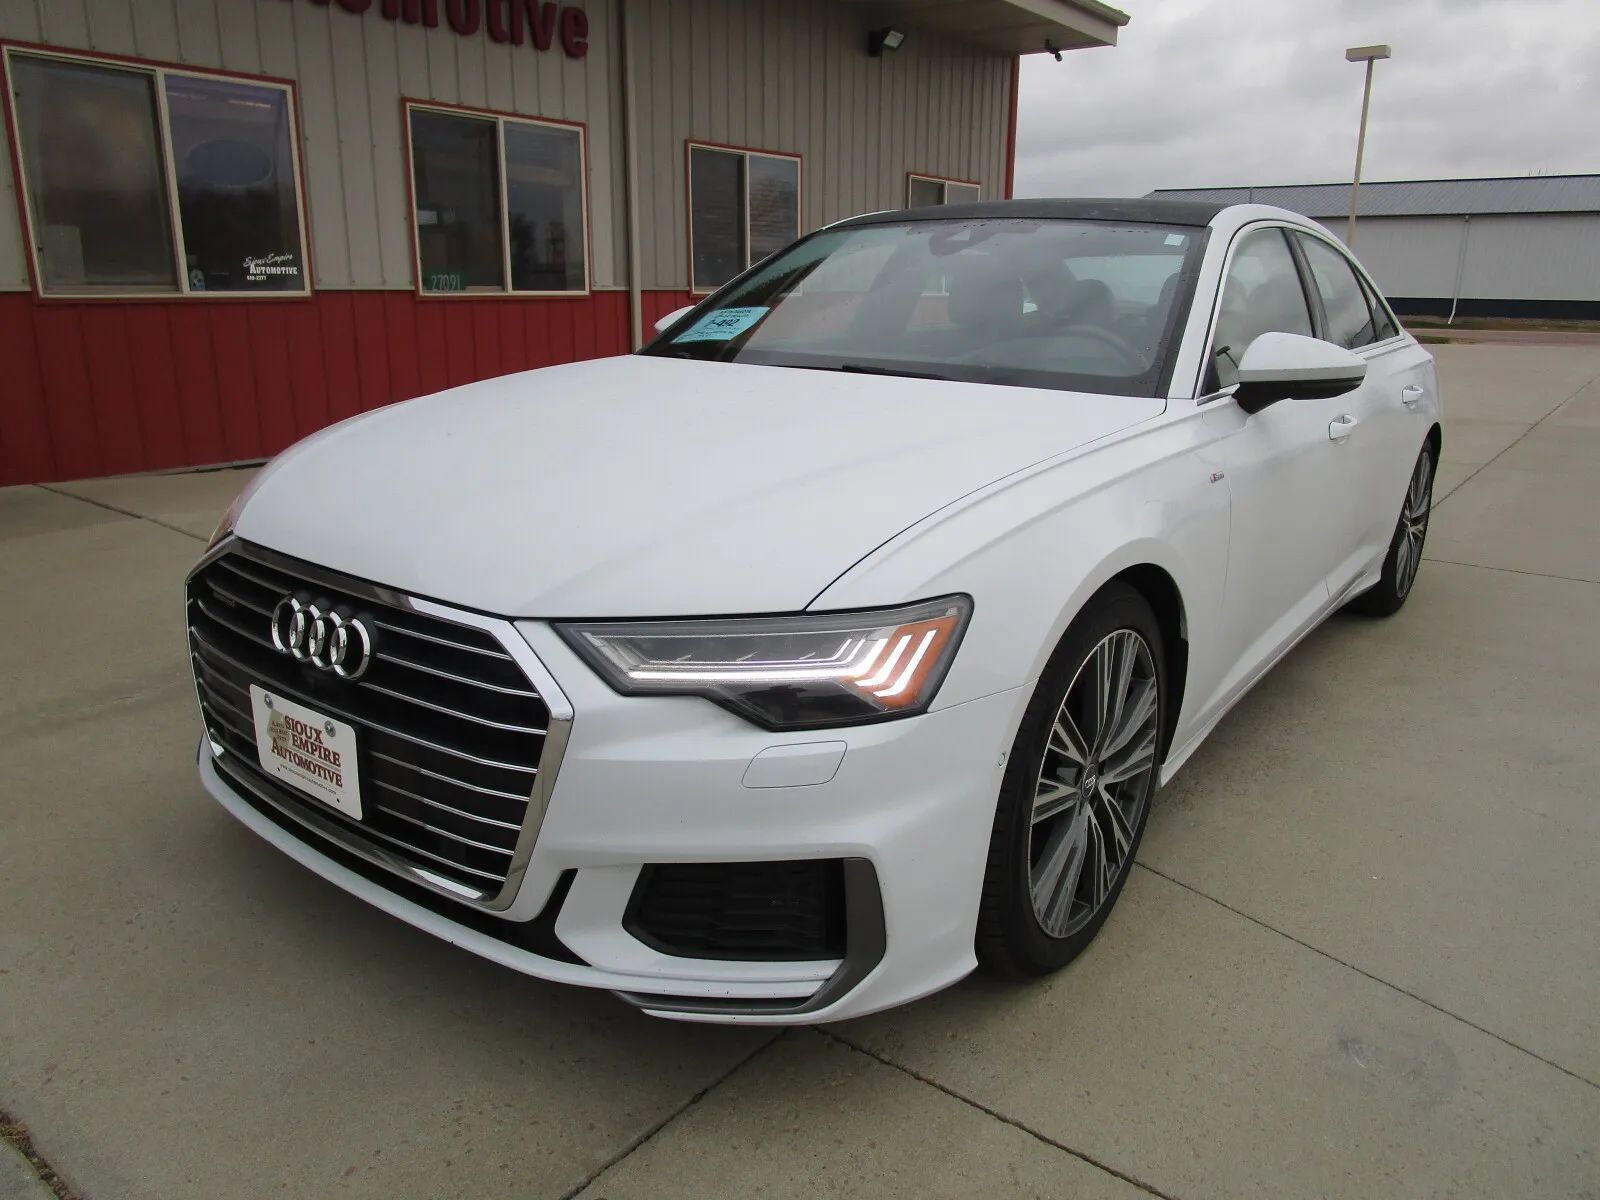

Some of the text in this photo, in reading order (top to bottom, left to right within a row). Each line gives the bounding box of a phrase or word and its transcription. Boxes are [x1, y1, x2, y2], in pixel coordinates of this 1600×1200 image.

[303, 0, 589, 58] otive
[249, 264, 298, 274] AUTOMOTIVE
[266, 253, 293, 264] Empire
[431, 275, 461, 291] 27091
[284, 715, 323, 745] SIOUX
[271, 737, 343, 788] AUTOMOTIVE
[291, 733, 341, 768] EMPIRE
